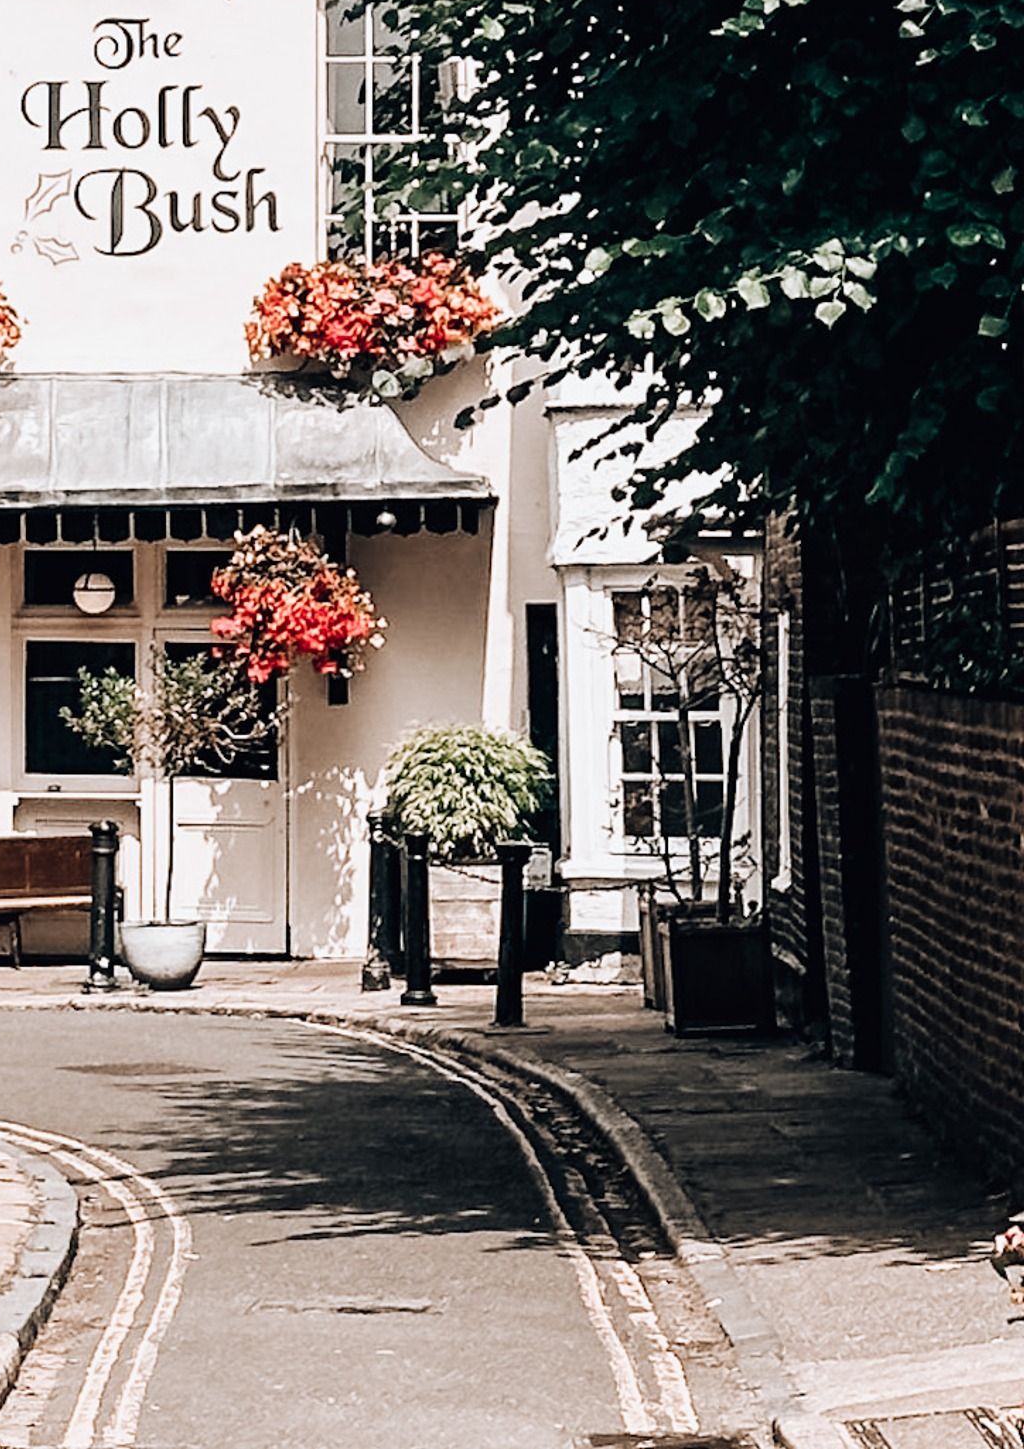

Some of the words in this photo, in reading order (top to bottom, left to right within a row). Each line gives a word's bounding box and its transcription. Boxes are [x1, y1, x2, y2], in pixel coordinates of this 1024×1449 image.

[92, 17, 183, 70] The
[20, 80, 241, 183] Holly
[73, 167, 282, 257] Bush
